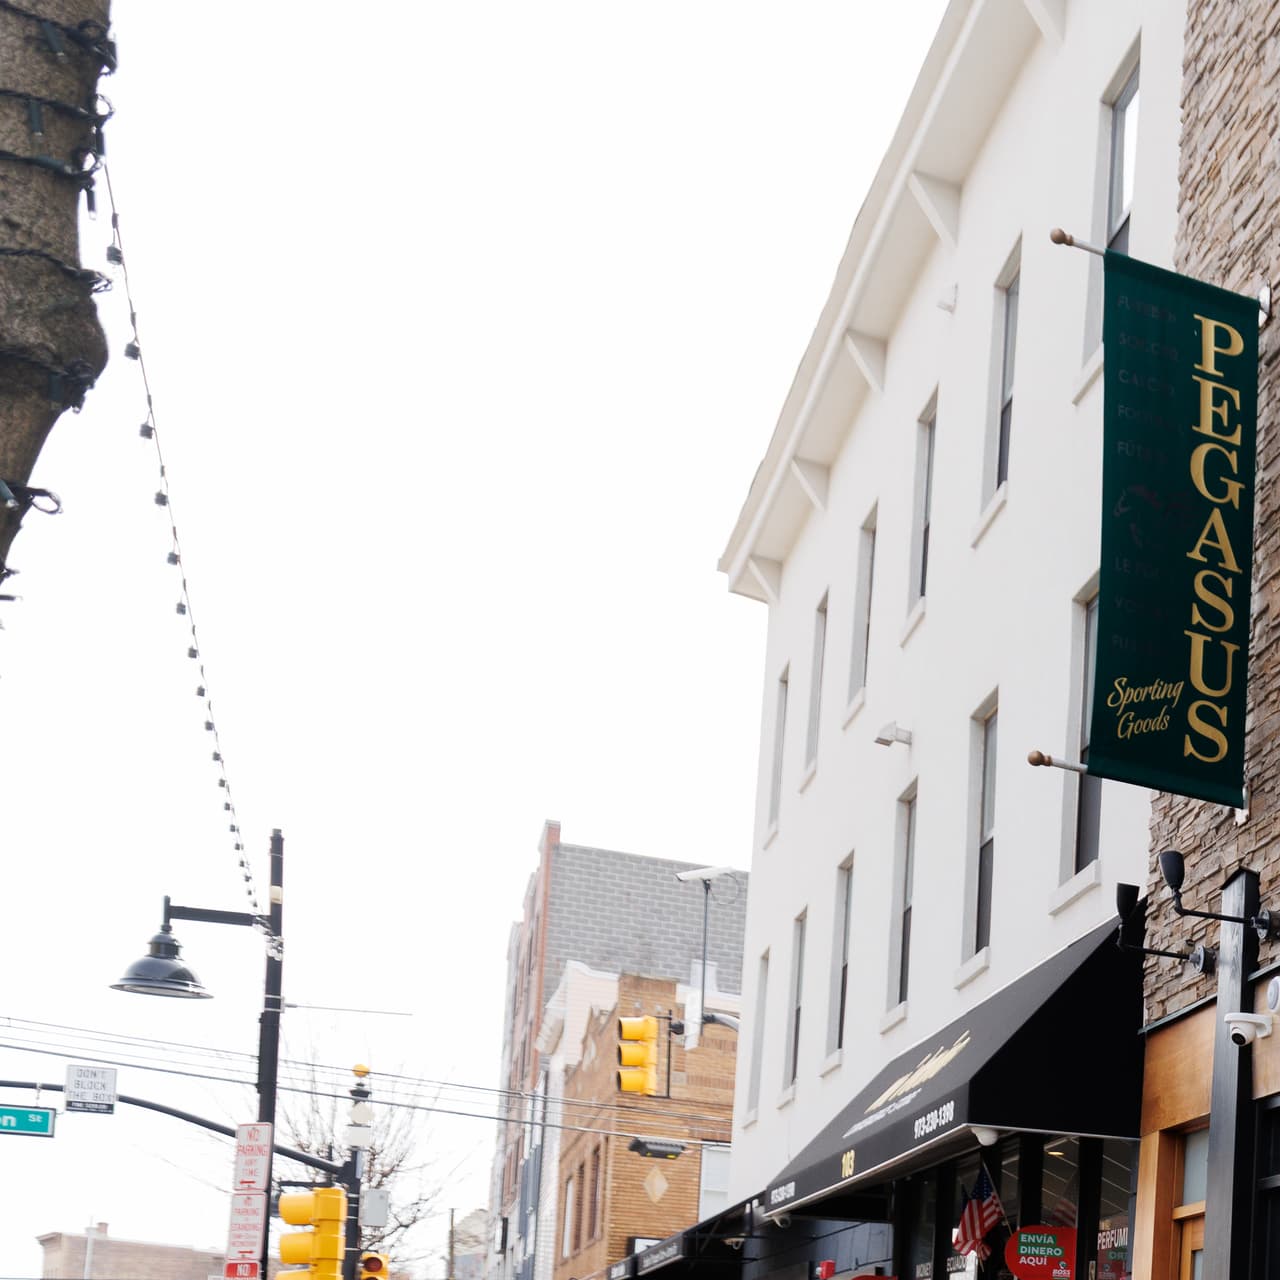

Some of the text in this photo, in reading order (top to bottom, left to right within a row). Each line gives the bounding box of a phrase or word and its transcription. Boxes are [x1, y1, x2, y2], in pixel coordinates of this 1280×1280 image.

[1184, 314, 1246, 763] PEGASUS
[1107, 677, 1184, 716] Sporting
[1118, 705, 1170, 740] Goods
[237, 1144, 268, 1157] PARKING
[1020, 1233, 1055, 1245] ENVÍA
[1020, 1245, 1062, 1256] DINERO
[1019, 1256, 1047, 1267] AQUÍ
[236, 1263, 251, 1277] NO
